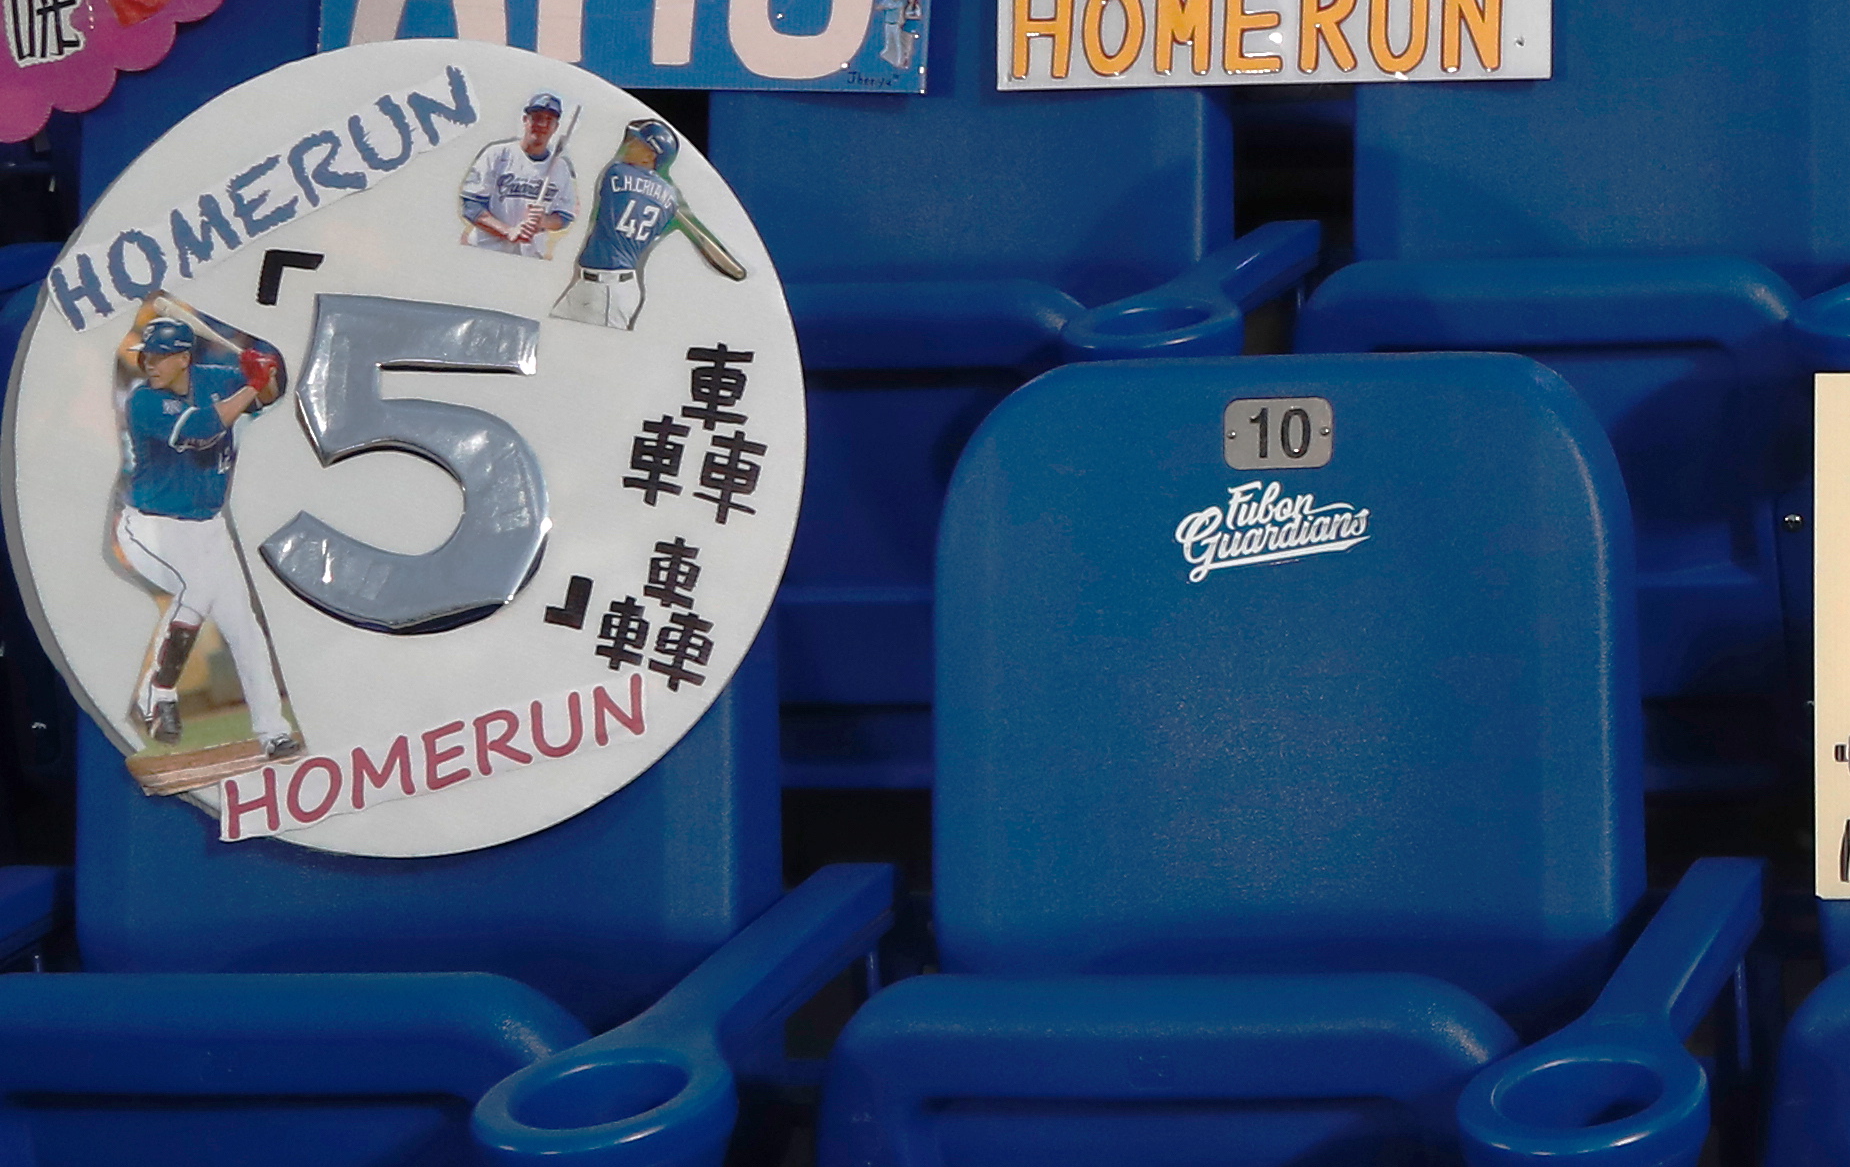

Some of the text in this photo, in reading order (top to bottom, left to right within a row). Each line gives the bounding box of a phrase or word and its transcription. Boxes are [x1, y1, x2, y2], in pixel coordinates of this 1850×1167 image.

[52, 67, 478, 329] HOMERUN
[616, 199, 662, 241] 42
[1250, 407, 1312, 459] 10
[1228, 480, 1315, 531] Fubon
[1175, 505, 1371, 583] Guardians
[225, 674, 648, 839] HOMERUN
